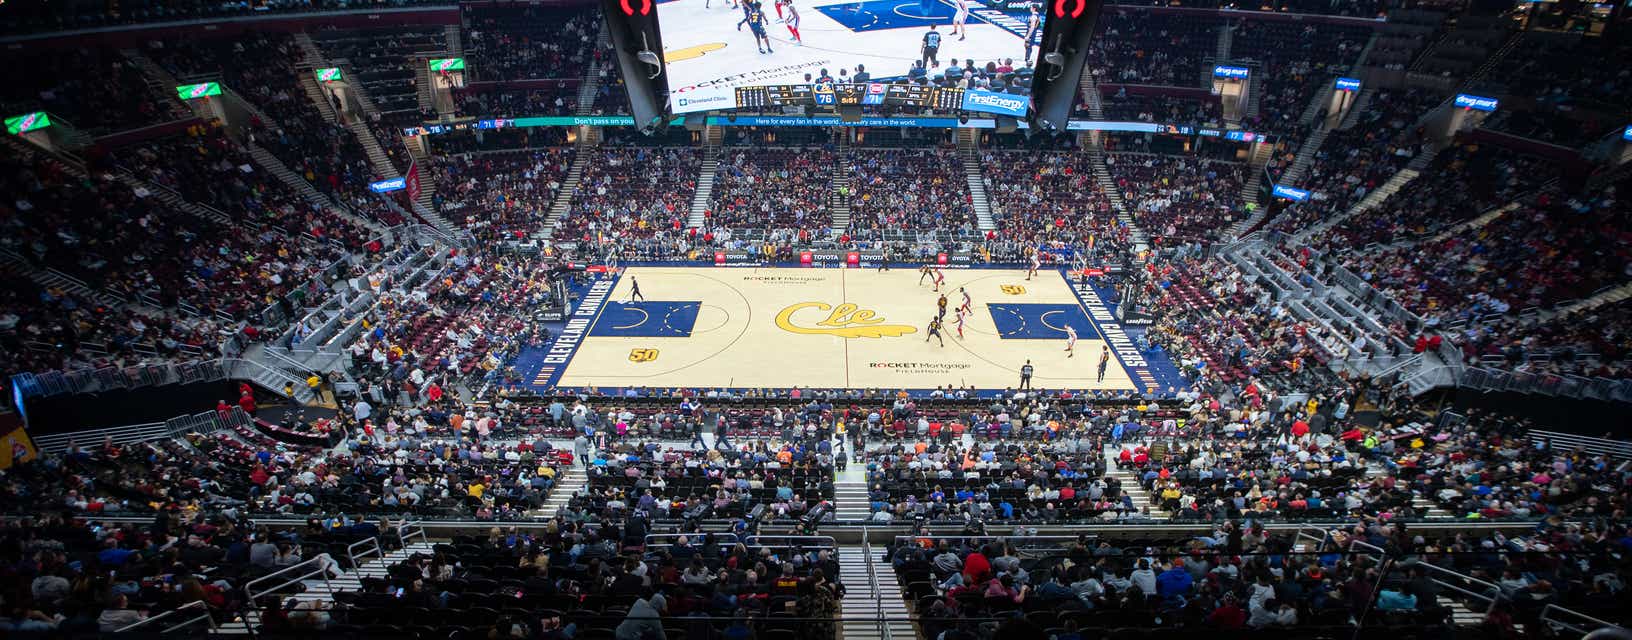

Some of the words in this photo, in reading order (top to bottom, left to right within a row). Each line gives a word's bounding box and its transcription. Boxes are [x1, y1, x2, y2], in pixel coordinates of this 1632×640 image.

[819, 95, 832, 103] 76
[869, 95, 879, 103] 71
[1000, 285, 1027, 295] 50
[543, 318, 590, 363] CLEVELAND
[575, 280, 614, 316] CAVALIERS
[1099, 323, 1148, 367] CAVALIERS
[628, 349, 659, 362] 50
